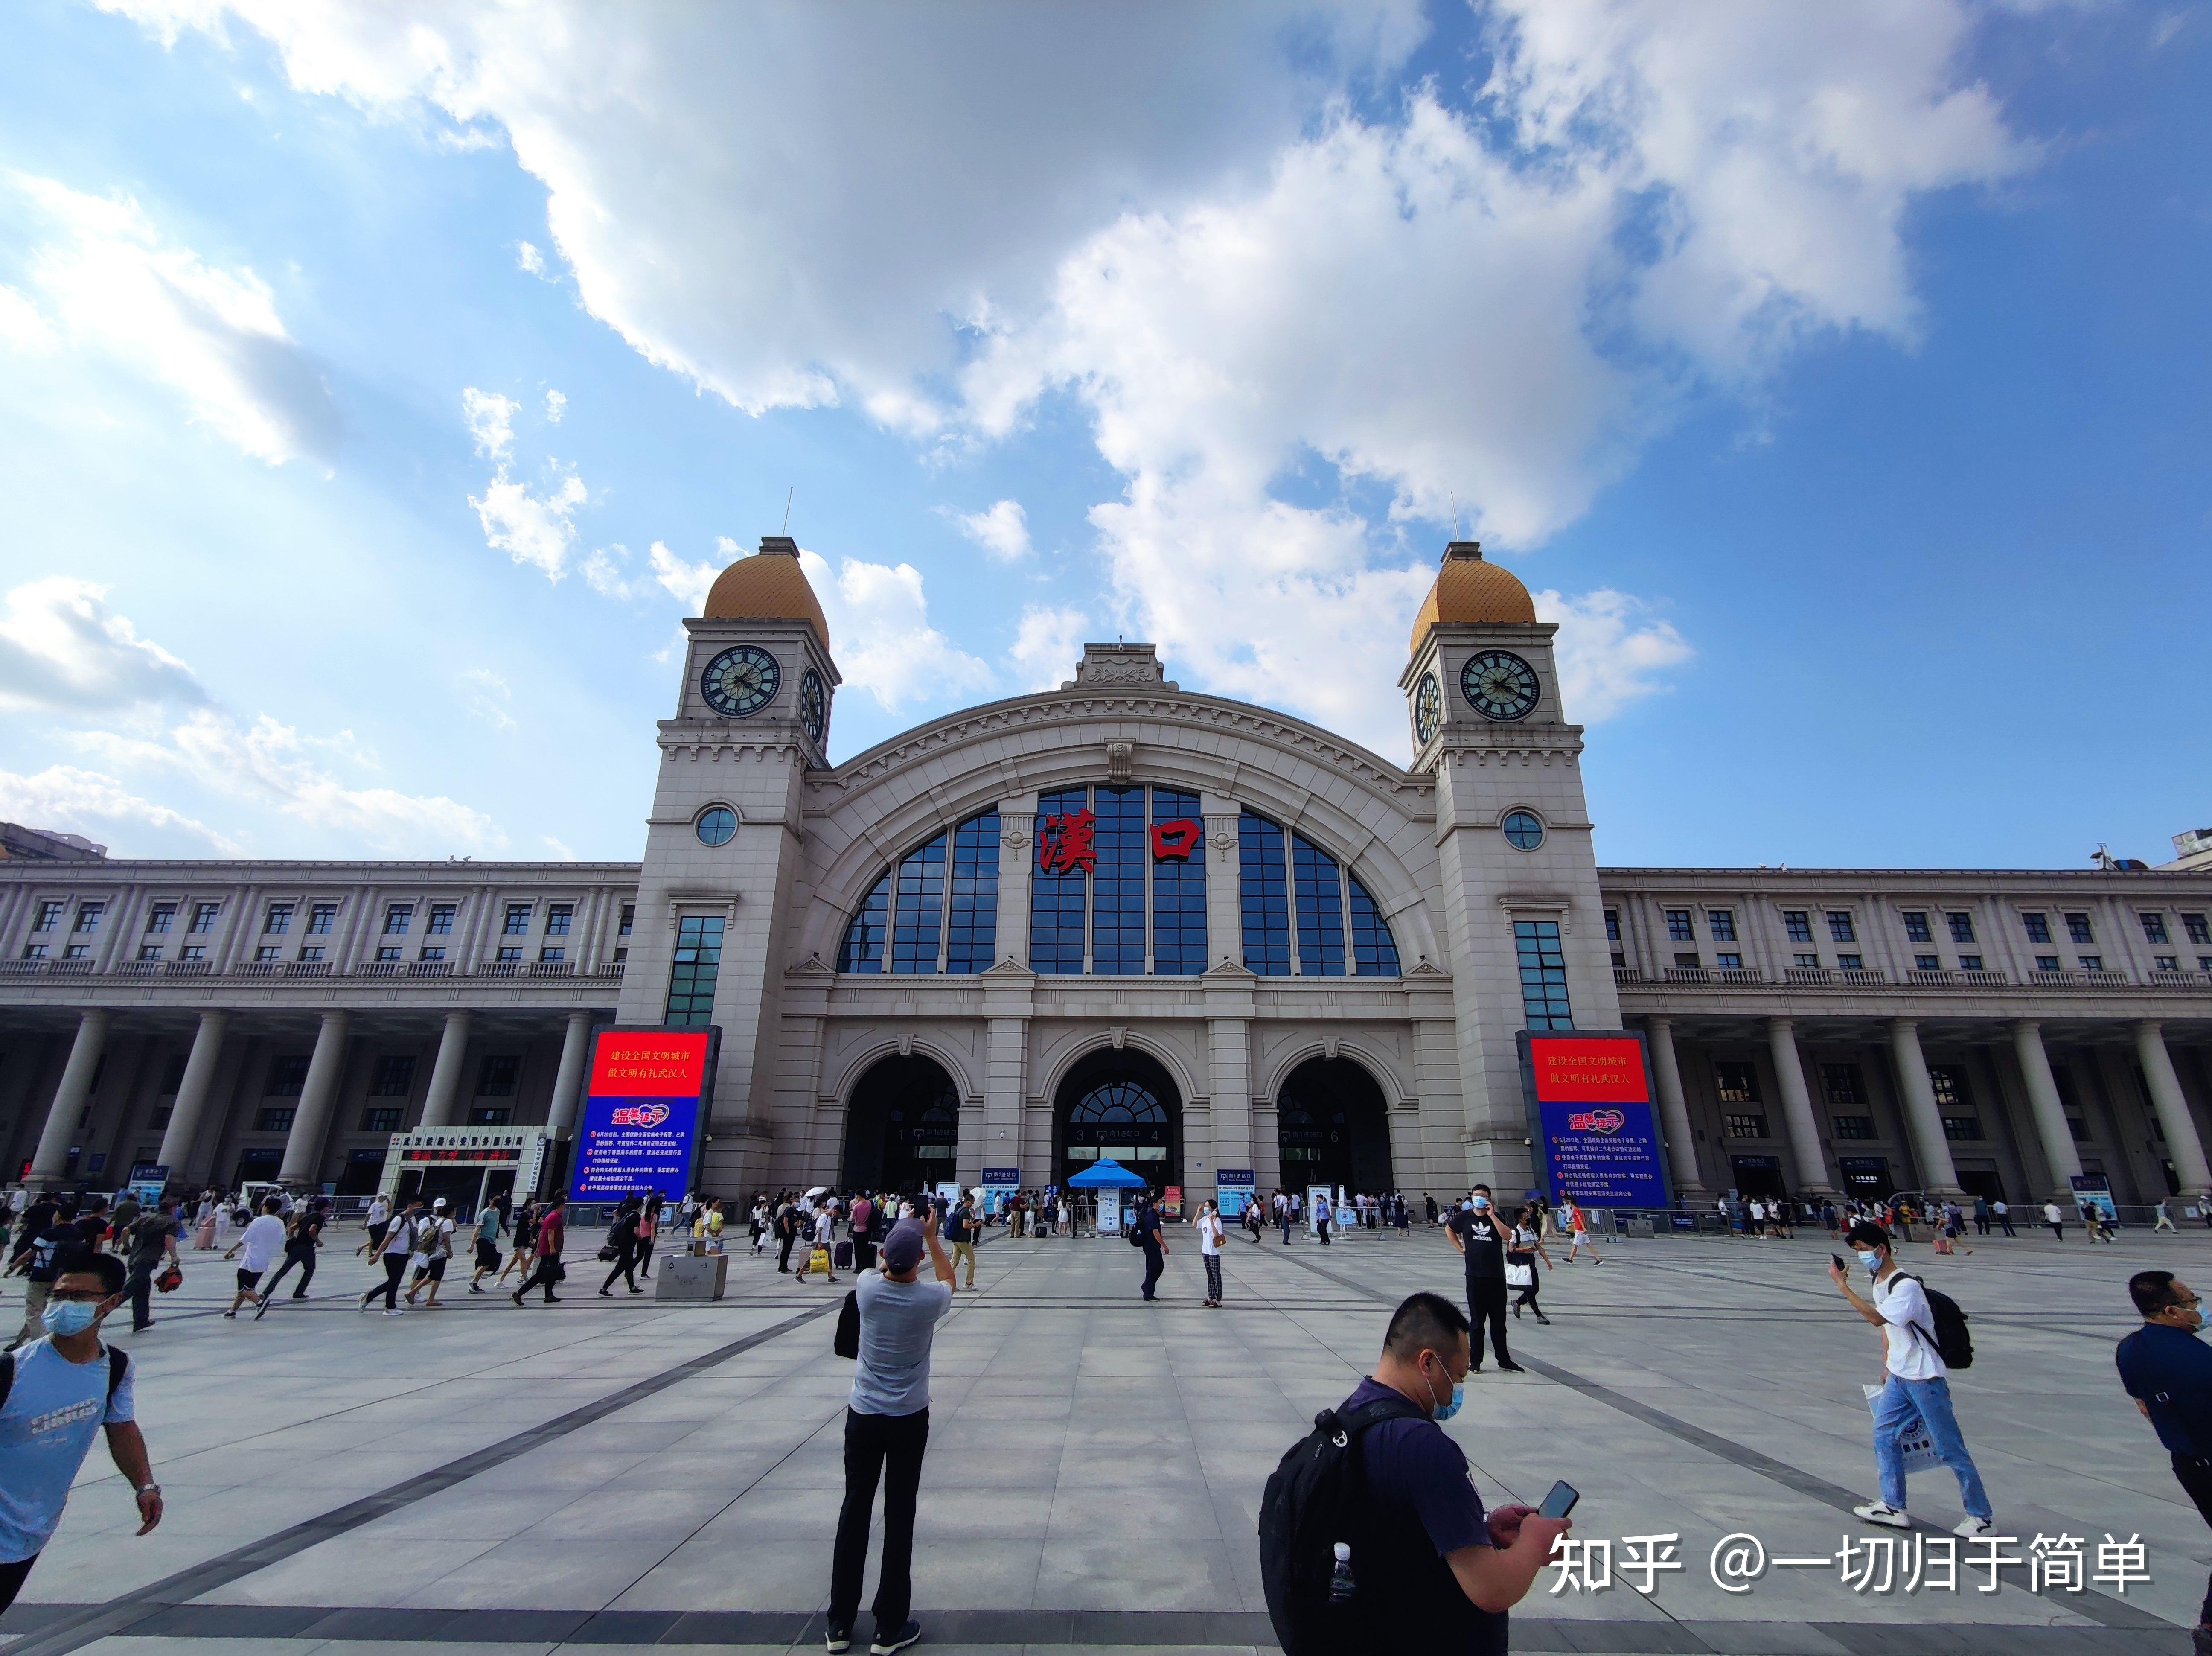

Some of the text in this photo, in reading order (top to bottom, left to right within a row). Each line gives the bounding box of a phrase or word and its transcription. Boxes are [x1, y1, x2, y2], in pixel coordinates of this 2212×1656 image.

[610, 1050, 690, 1061] 建设全国文明城市
[1548, 1056, 1627, 1067] 建设全国文明城市
[608, 1067, 687, 1078] 做文明有礼武汉人
[1550, 1073, 1630, 1084] 做文明有礼武汉人
[611, 1107, 664, 1125] 温馨提示
[1568, 1113, 1619, 1130] 温馨提示
[1077, 1129, 1084, 1141] 3
[1151, 1130, 1158, 1142] 4
[1331, 1131, 1338, 1142] 6
